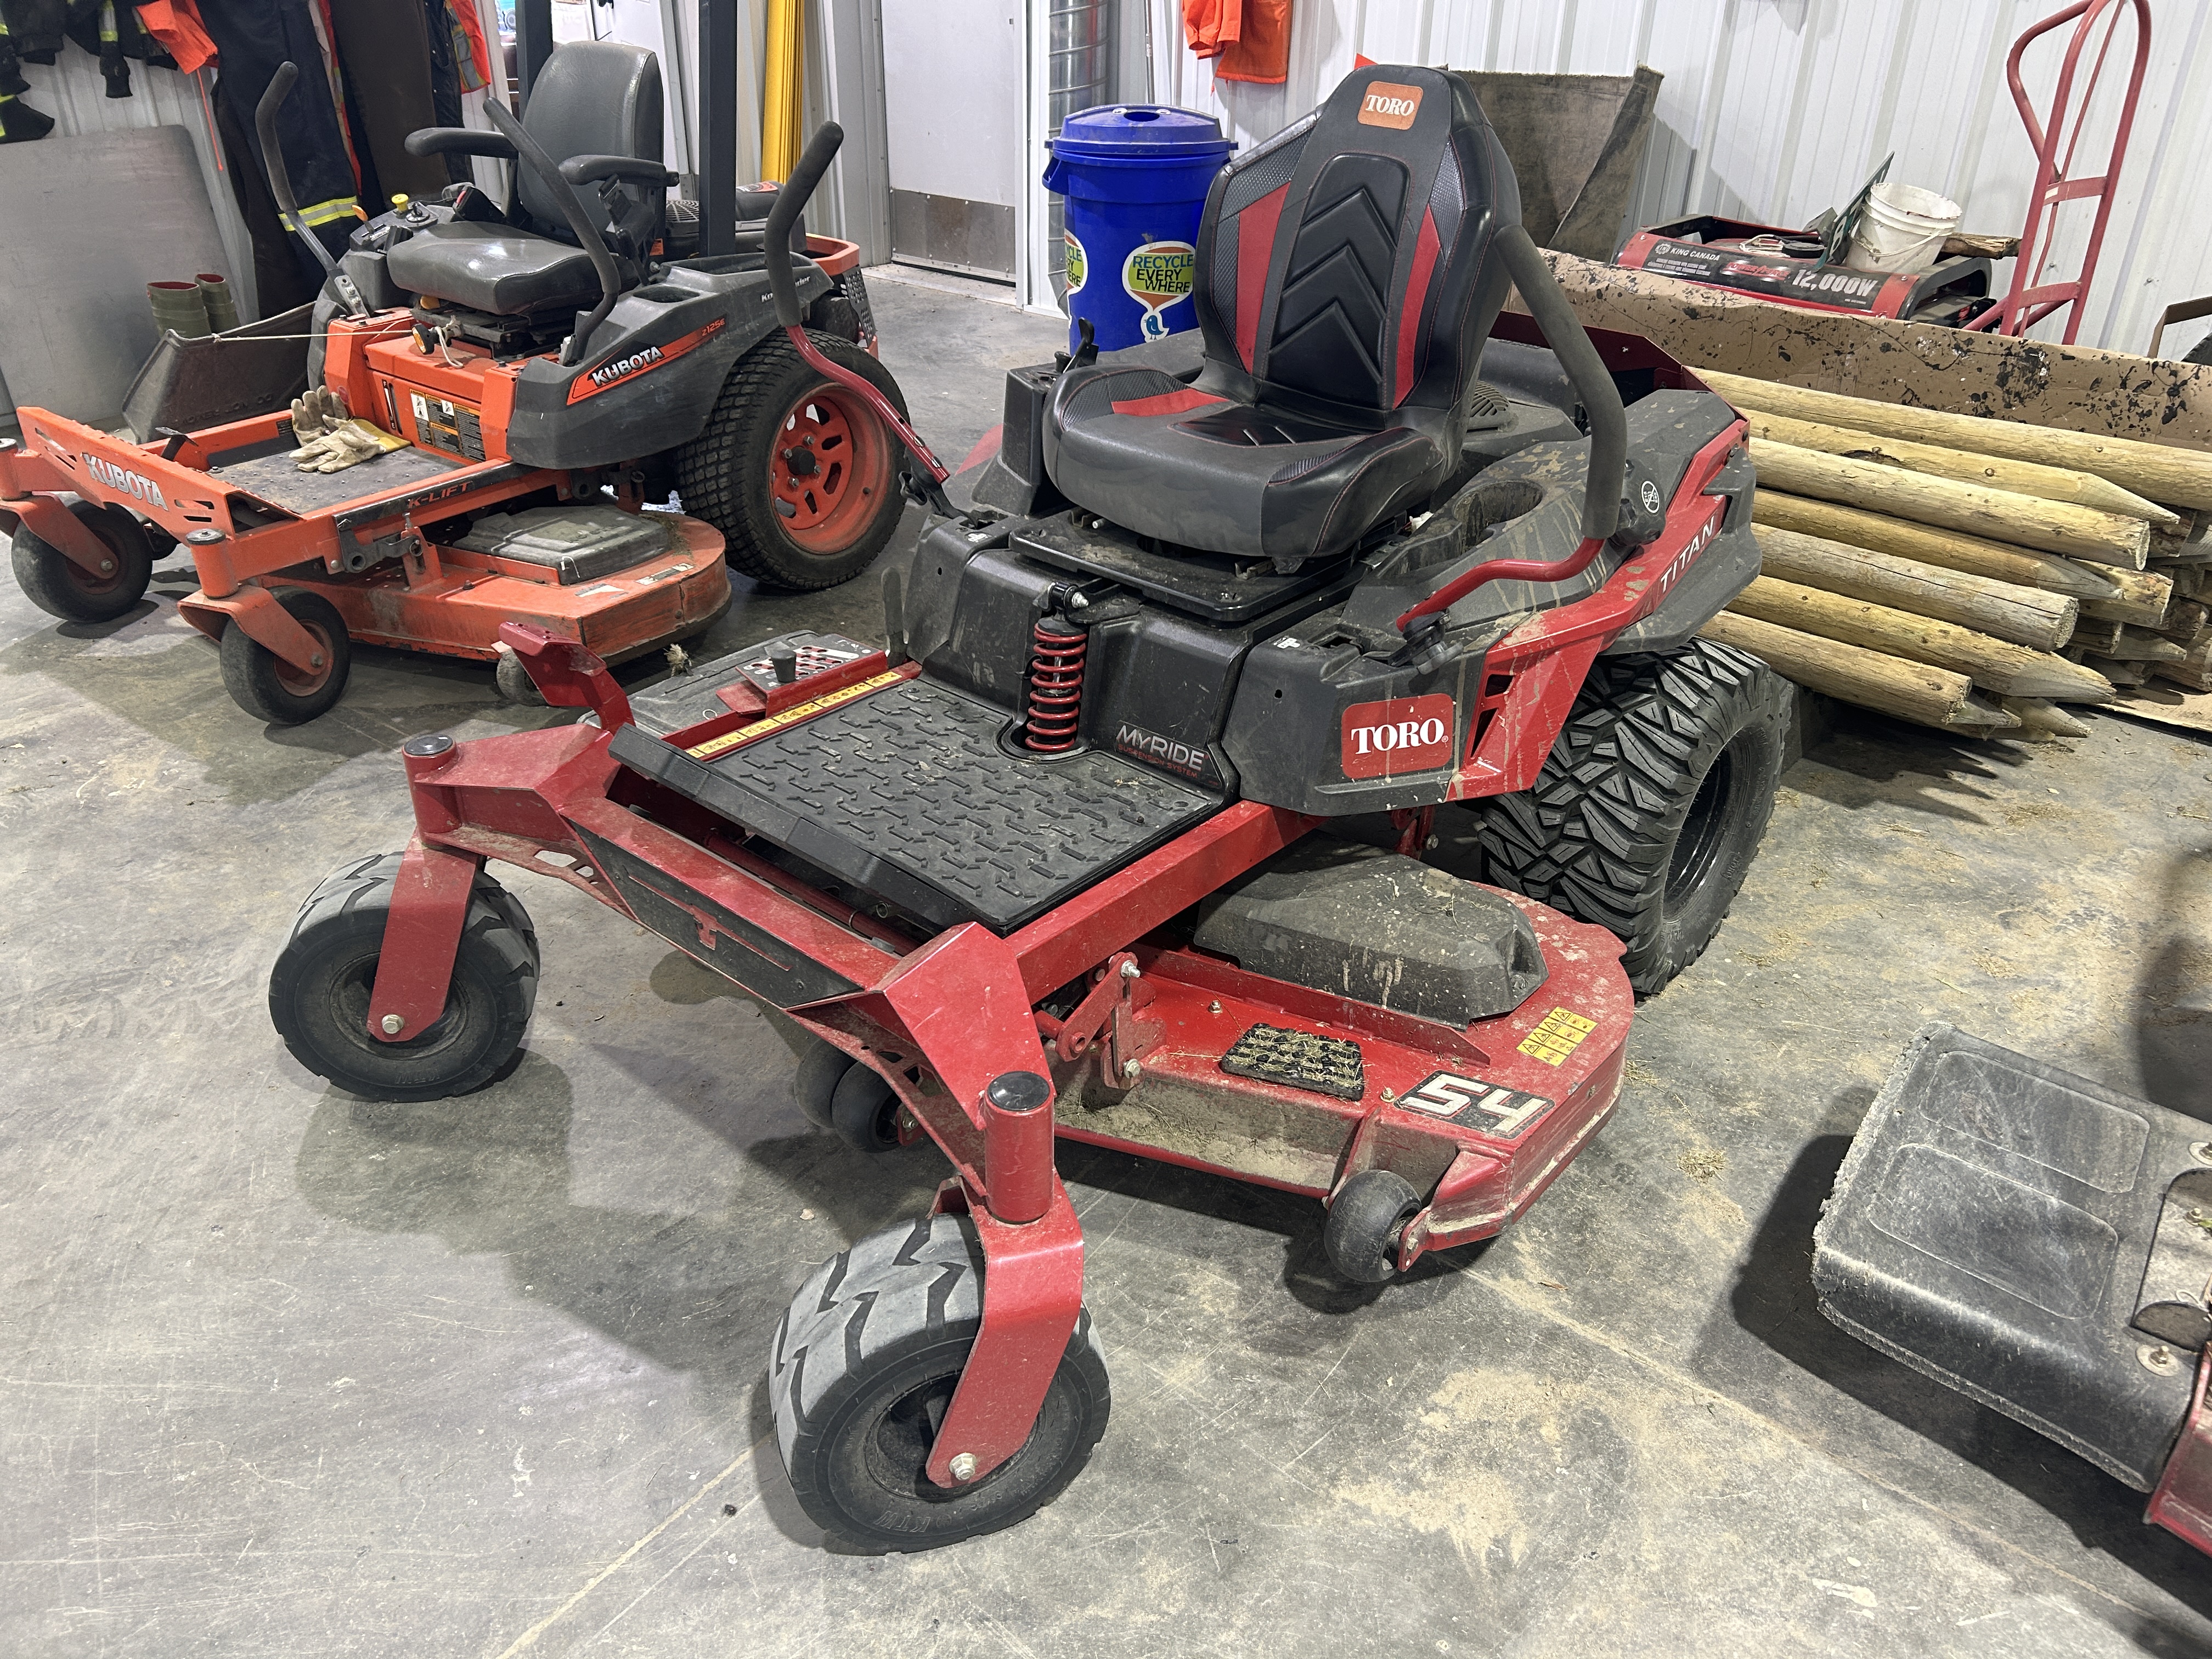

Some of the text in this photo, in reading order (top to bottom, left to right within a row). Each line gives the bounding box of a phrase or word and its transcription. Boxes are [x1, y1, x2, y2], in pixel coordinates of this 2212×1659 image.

[1365, 95, 1414, 116] TORO
[1133, 254, 1194, 269] RECYCLE
[1669, 248, 1720, 261] KING CANADA
[1136, 269, 1182, 281] EVERY
[1145, 279, 1190, 292] WHERE
[1792, 269, 1878, 297] 12,000W
[591, 346, 664, 386] KUBOTA
[82, 453, 169, 511] KUBOTA
[408, 481, 471, 509] K-LIFT
[1661, 515, 1715, 593] TITAN
[1351, 718, 1445, 754] TORO
[1118, 743, 1198, 778] SUSPENSION SYSTEM
[1401, 1074, 1547, 1133] 54
